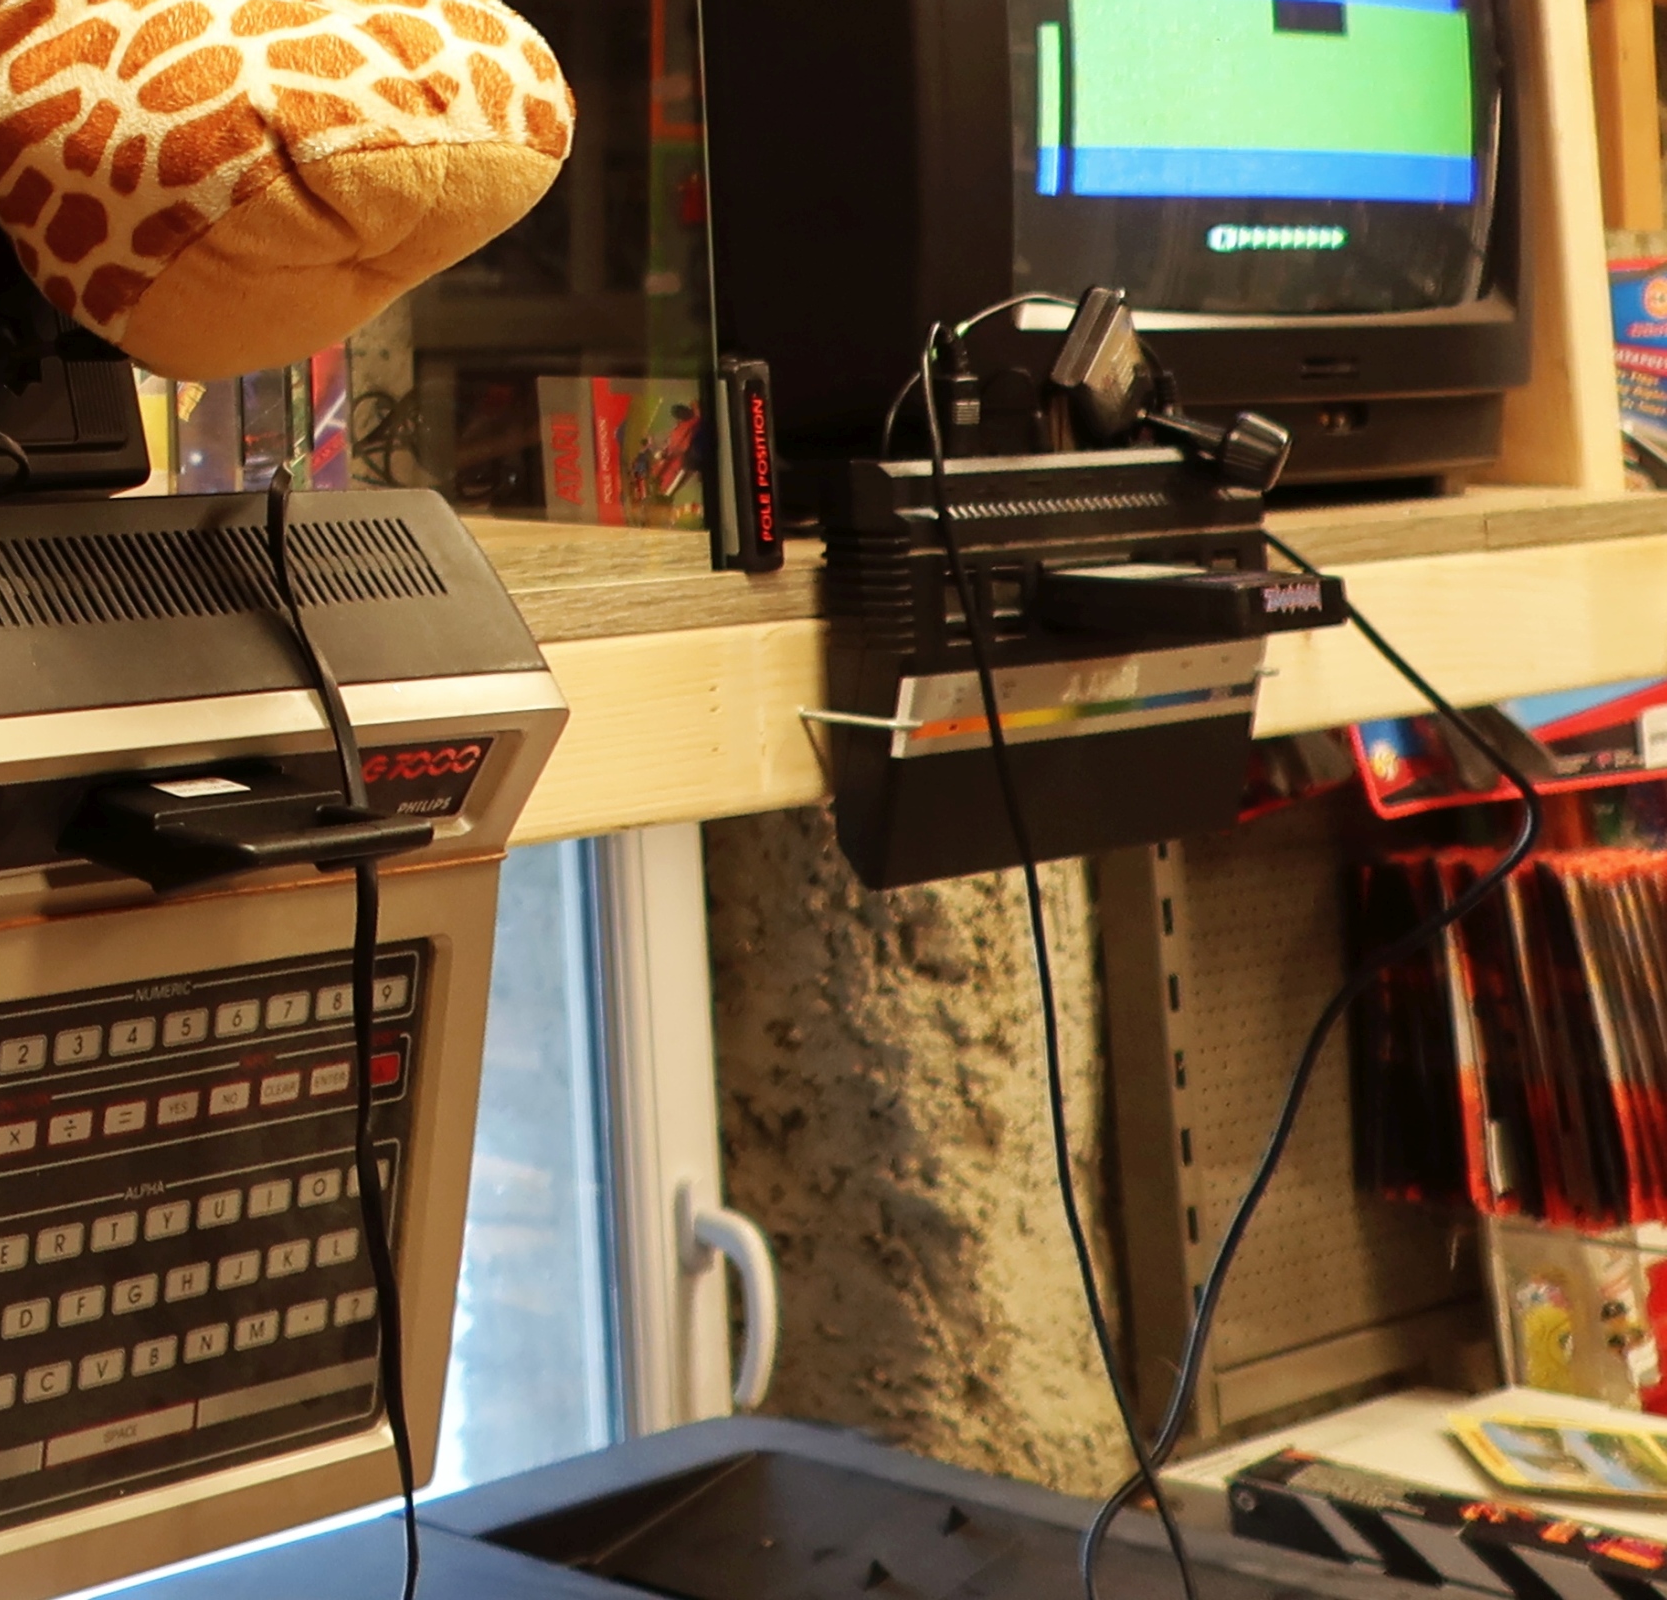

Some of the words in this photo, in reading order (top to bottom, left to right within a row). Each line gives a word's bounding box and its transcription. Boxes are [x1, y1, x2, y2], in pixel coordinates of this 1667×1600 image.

[550, 416, 585, 506] ATARI
[751, 398, 770, 487] POSITION
[757, 493, 774, 542] POLE
[396, 796, 452, 814] PHILIPS
[18, 1044, 29, 1064] 2
[72, 1035, 83, 1055] 3
[126, 1026, 138, 1045] 4
[180, 1017, 191, 1036] 5
[232, 1009, 242, 1028] 6
[283, 1000, 294, 1019] 7
[333, 992, 342, 1010] 8
[382, 984, 393, 1002] 9
[134, 981, 192, 1002] NUMERIC
[0, 1245, 9, 1264] E
[54, 1234, 65, 1253] R
[109, 1222, 119, 1241] T
[163, 1211, 174, 1230] Y
[213, 1200, 224, 1218] U
[19, 1309, 32, 1330] D
[76, 1296, 87, 1317] F
[127, 1285, 142, 1304] G
[181, 1273, 193, 1292] H
[233, 1261, 244, 1280] J
[282, 1249, 293, 1268] K
[332, 1239, 341, 1256] L
[39, 1371, 55, 1392] C
[95, 1360, 108, 1379] V
[148, 1347, 160, 1367] B
[199, 1333, 213, 1352] N
[250, 1321, 266, 1340] M
